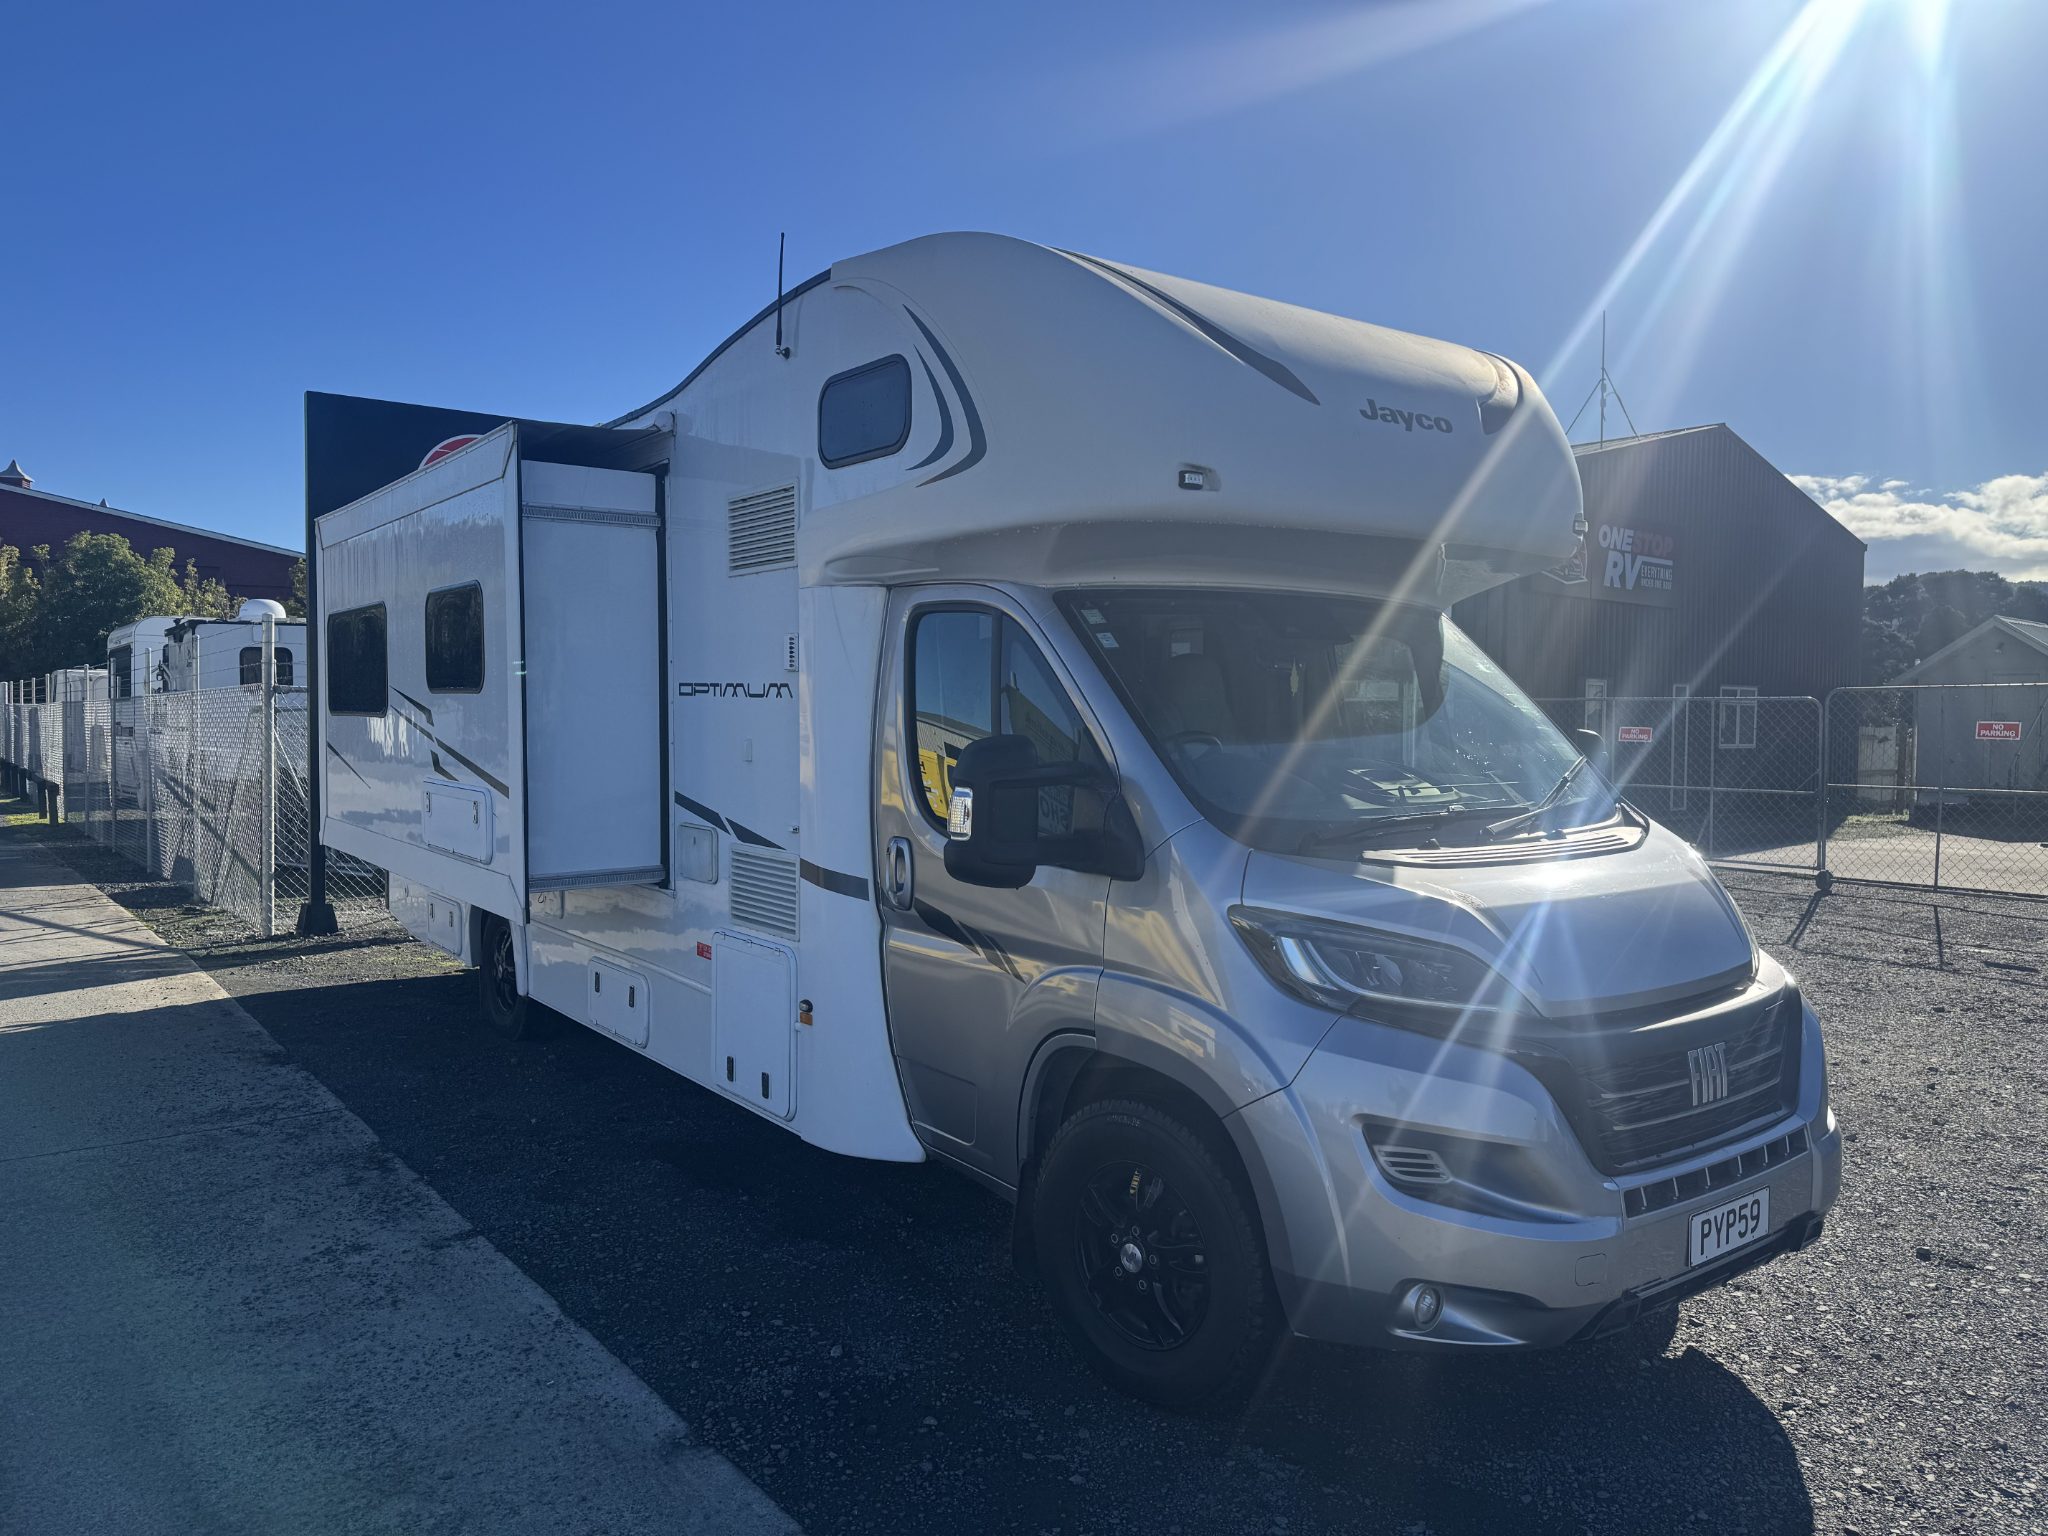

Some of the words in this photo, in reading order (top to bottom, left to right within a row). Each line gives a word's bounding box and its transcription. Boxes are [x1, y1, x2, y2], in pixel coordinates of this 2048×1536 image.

[1359, 398, 1453, 434] Jayco
[1599, 524, 1634, 551] ONE
[1632, 530, 1674, 557] STOP
[1603, 550, 1643, 590] RV
[679, 682, 793, 699] OPTIMUM
[1980, 729, 2016, 737] PARKING
[1687, 1041, 1728, 1107] FIAT
[1700, 1198, 1761, 1256] PYP59
